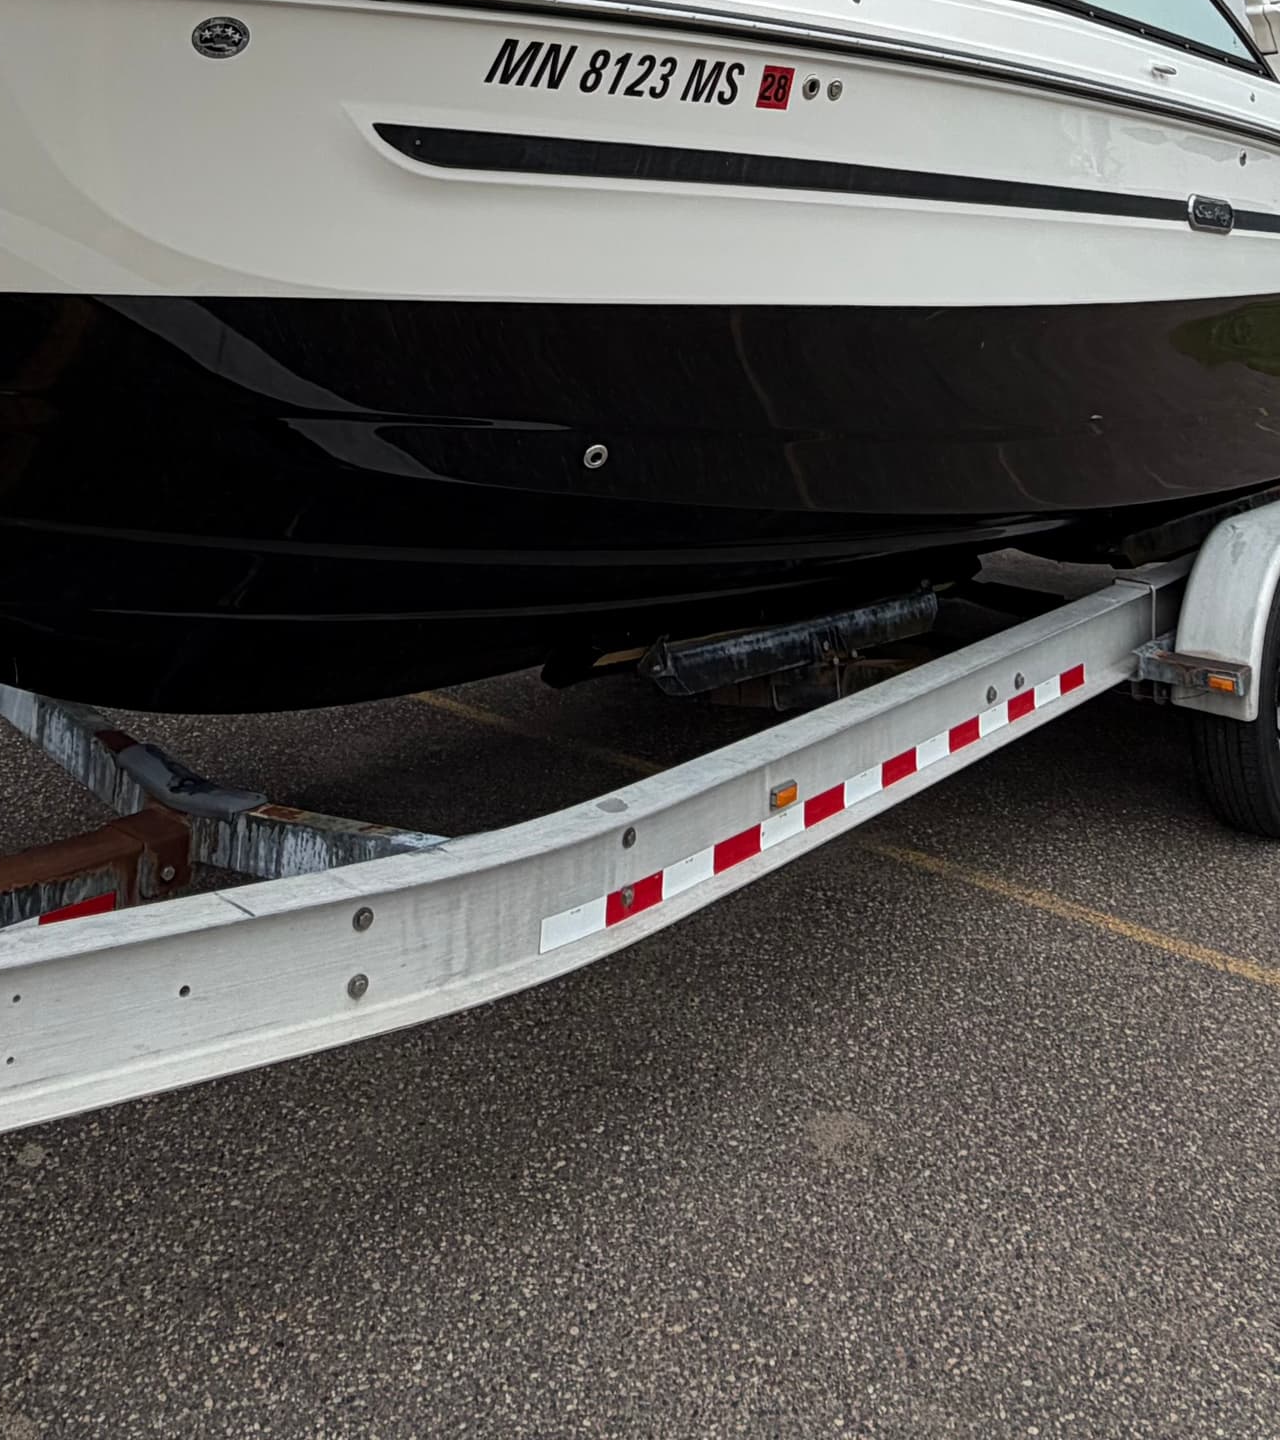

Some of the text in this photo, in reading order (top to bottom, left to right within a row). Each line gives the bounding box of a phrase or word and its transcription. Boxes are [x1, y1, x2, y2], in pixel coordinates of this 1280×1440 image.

[484, 38, 745, 105] MN 8123 MS
[759, 73, 789, 103] 28
